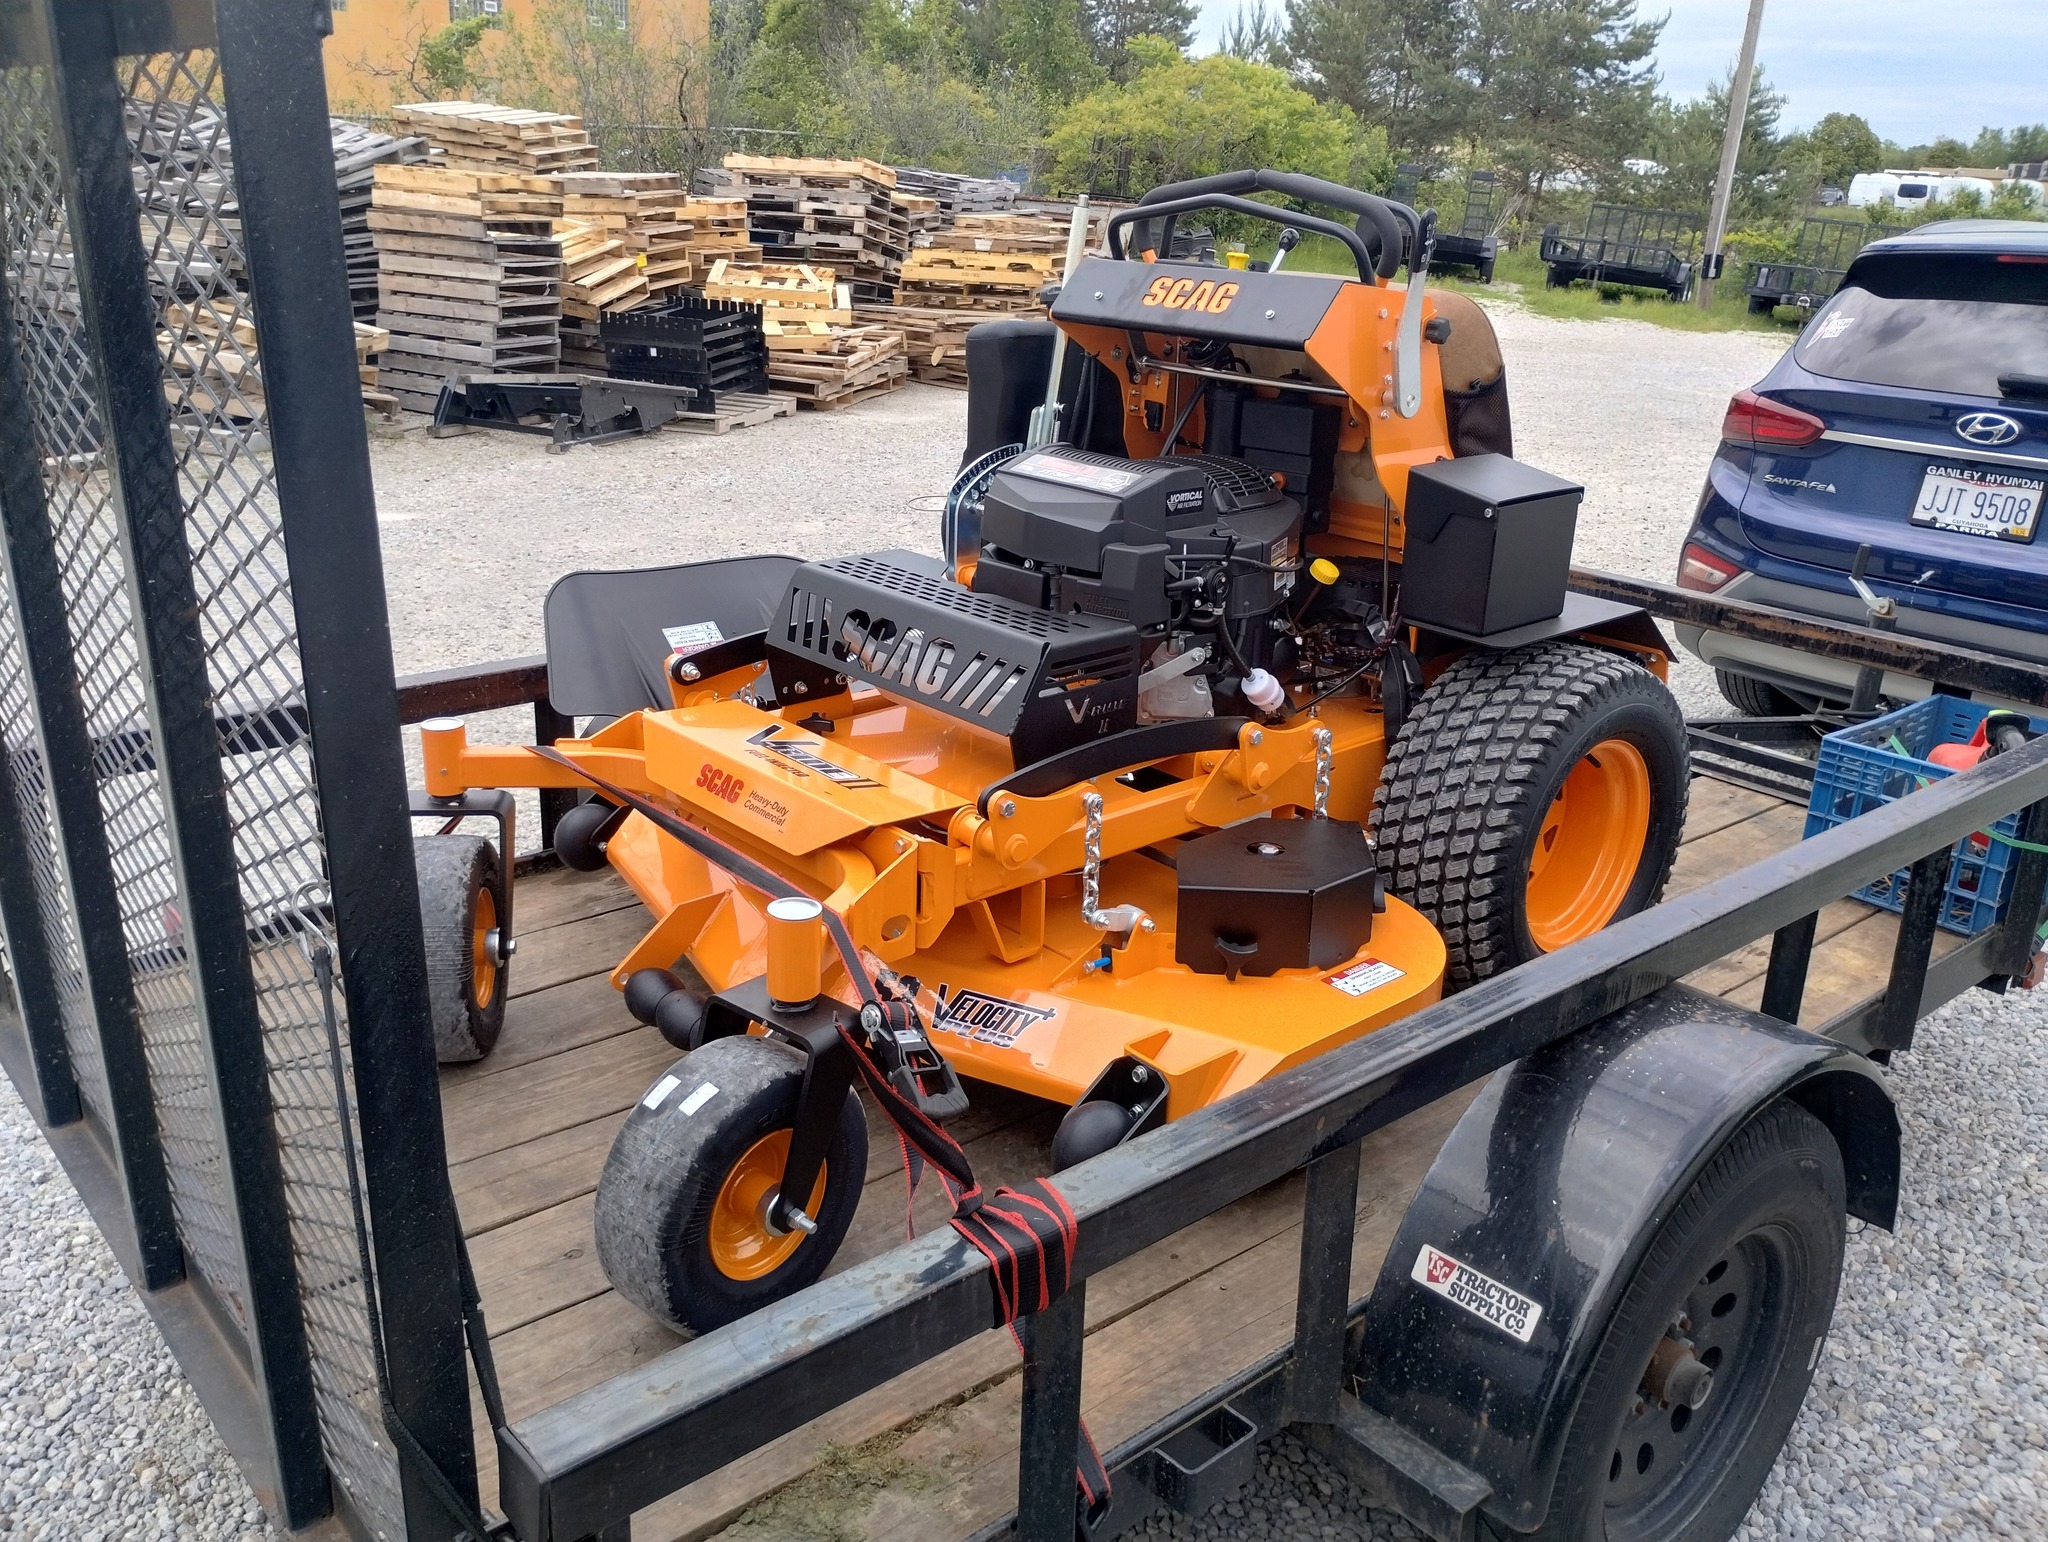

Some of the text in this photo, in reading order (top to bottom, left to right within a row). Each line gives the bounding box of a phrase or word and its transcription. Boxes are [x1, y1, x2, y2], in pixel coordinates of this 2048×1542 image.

[1142, 275, 1240, 314] SCAG
[1763, 474, 1808, 488] SANTA
[1926, 465, 1981, 481] GANLEY
[1986, 473, 2044, 491] HYUNDAI
[1170, 491, 1203, 502] VORTICAL
[1922, 485, 2031, 525] JJT 9508
[1934, 522, 1998, 537] PARMA
[1952, 518, 1988, 529] CUYAHOGA
[832, 608, 956, 695] SCAG
[697, 763, 744, 804] SCAG
[743, 799, 786, 827] Commercial
[748, 789, 789, 818] Heavy-Duty
[939, 1020, 1016, 1048] PLUS
[1427, 1253, 1450, 1283] TSC
[1447, 1281, 1507, 1324] SUPPLY
[1456, 1265, 1531, 1319] TRACTOR
